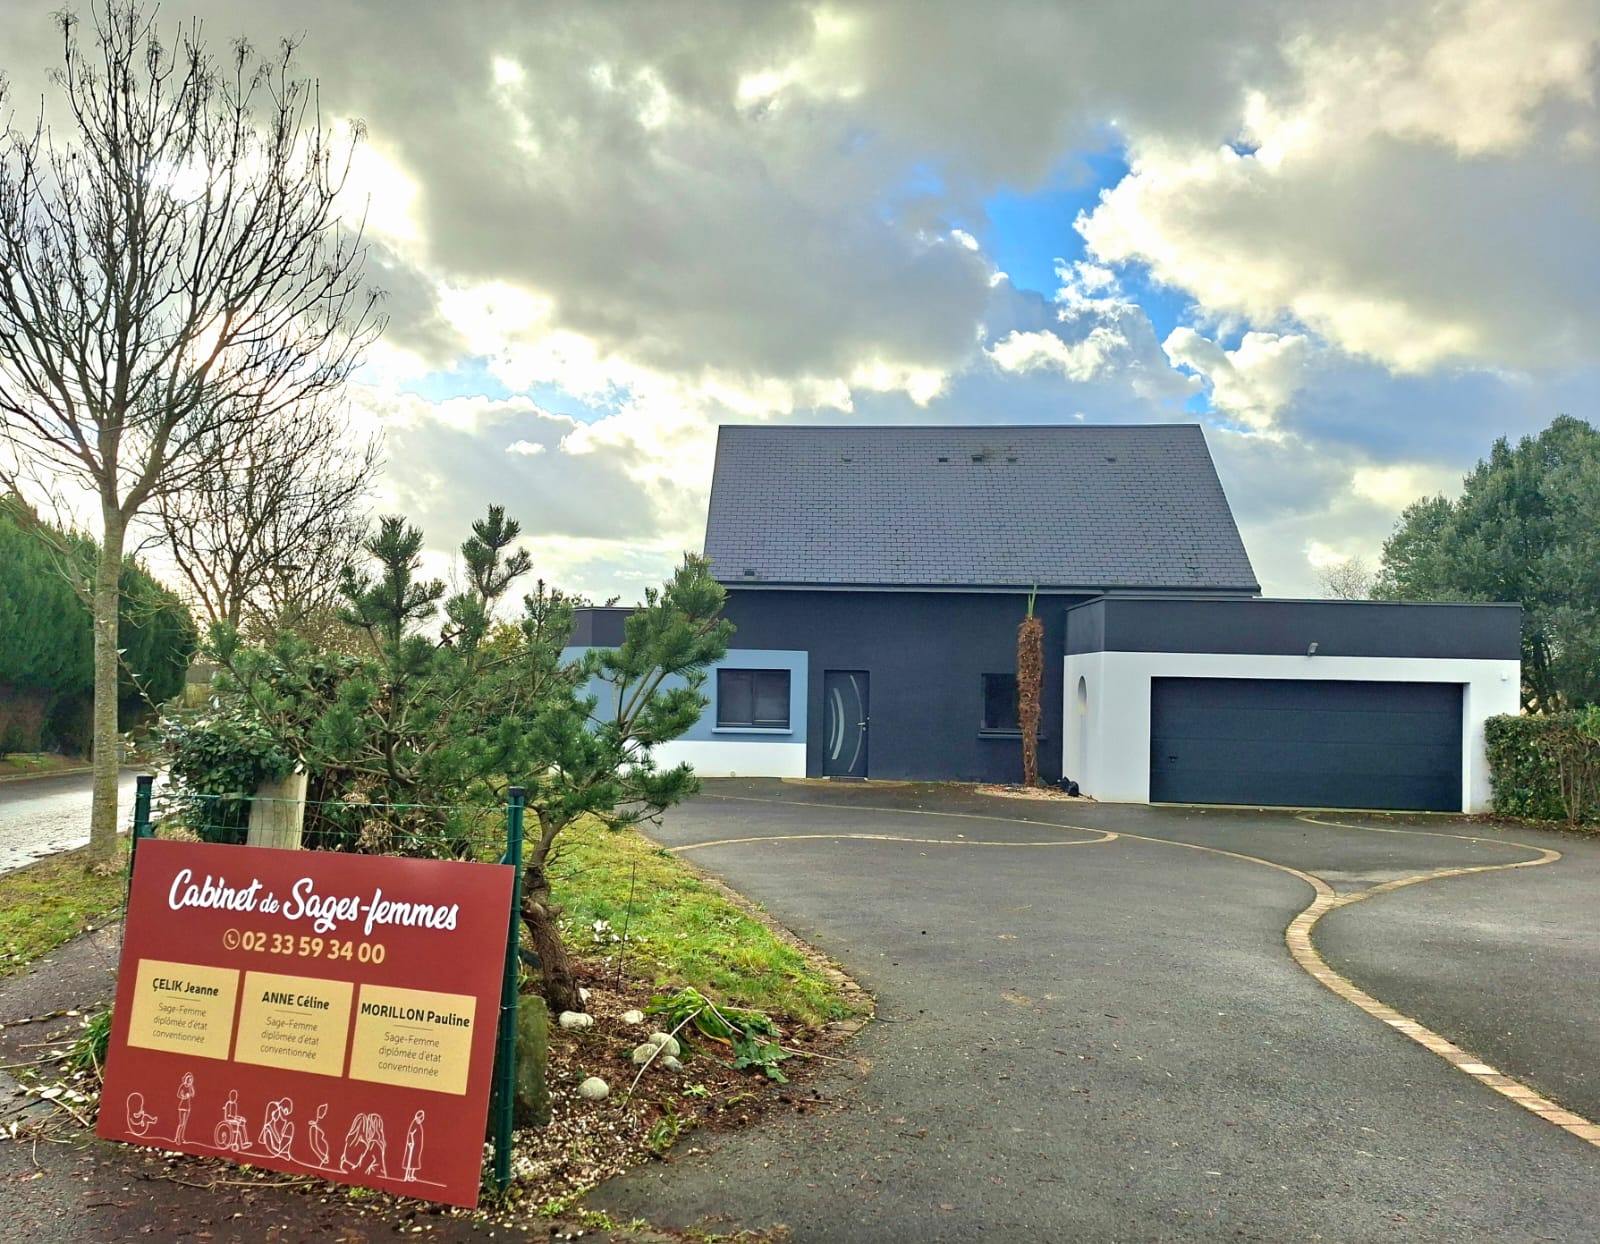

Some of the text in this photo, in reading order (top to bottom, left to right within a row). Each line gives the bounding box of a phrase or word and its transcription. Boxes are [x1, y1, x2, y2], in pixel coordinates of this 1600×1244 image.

[168, 868, 459, 936] Cabinet de Sages-femmes
[242, 931, 385, 964] 02 33 59 34 00
[152, 978, 219, 996] ÇELIK Jeanne
[261, 991, 330, 1010] ANNE Céline
[158, 1002, 207, 1017] Sage-Femme
[361, 1002, 470, 1027] MORILLON Pauline
[153, 1016, 186, 1028] diplômée
[265, 1016, 318, 1031] Sage-Femme
[152, 1029, 205, 1043] conventionnée
[261, 1030, 296, 1043] diplômée
[384, 1031, 440, 1048] Sage-Femme
[260, 1044, 317, 1059] conventionnée
[378, 1046, 416, 1060] diplômée
[378, 1061, 439, 1077] conventionnée
